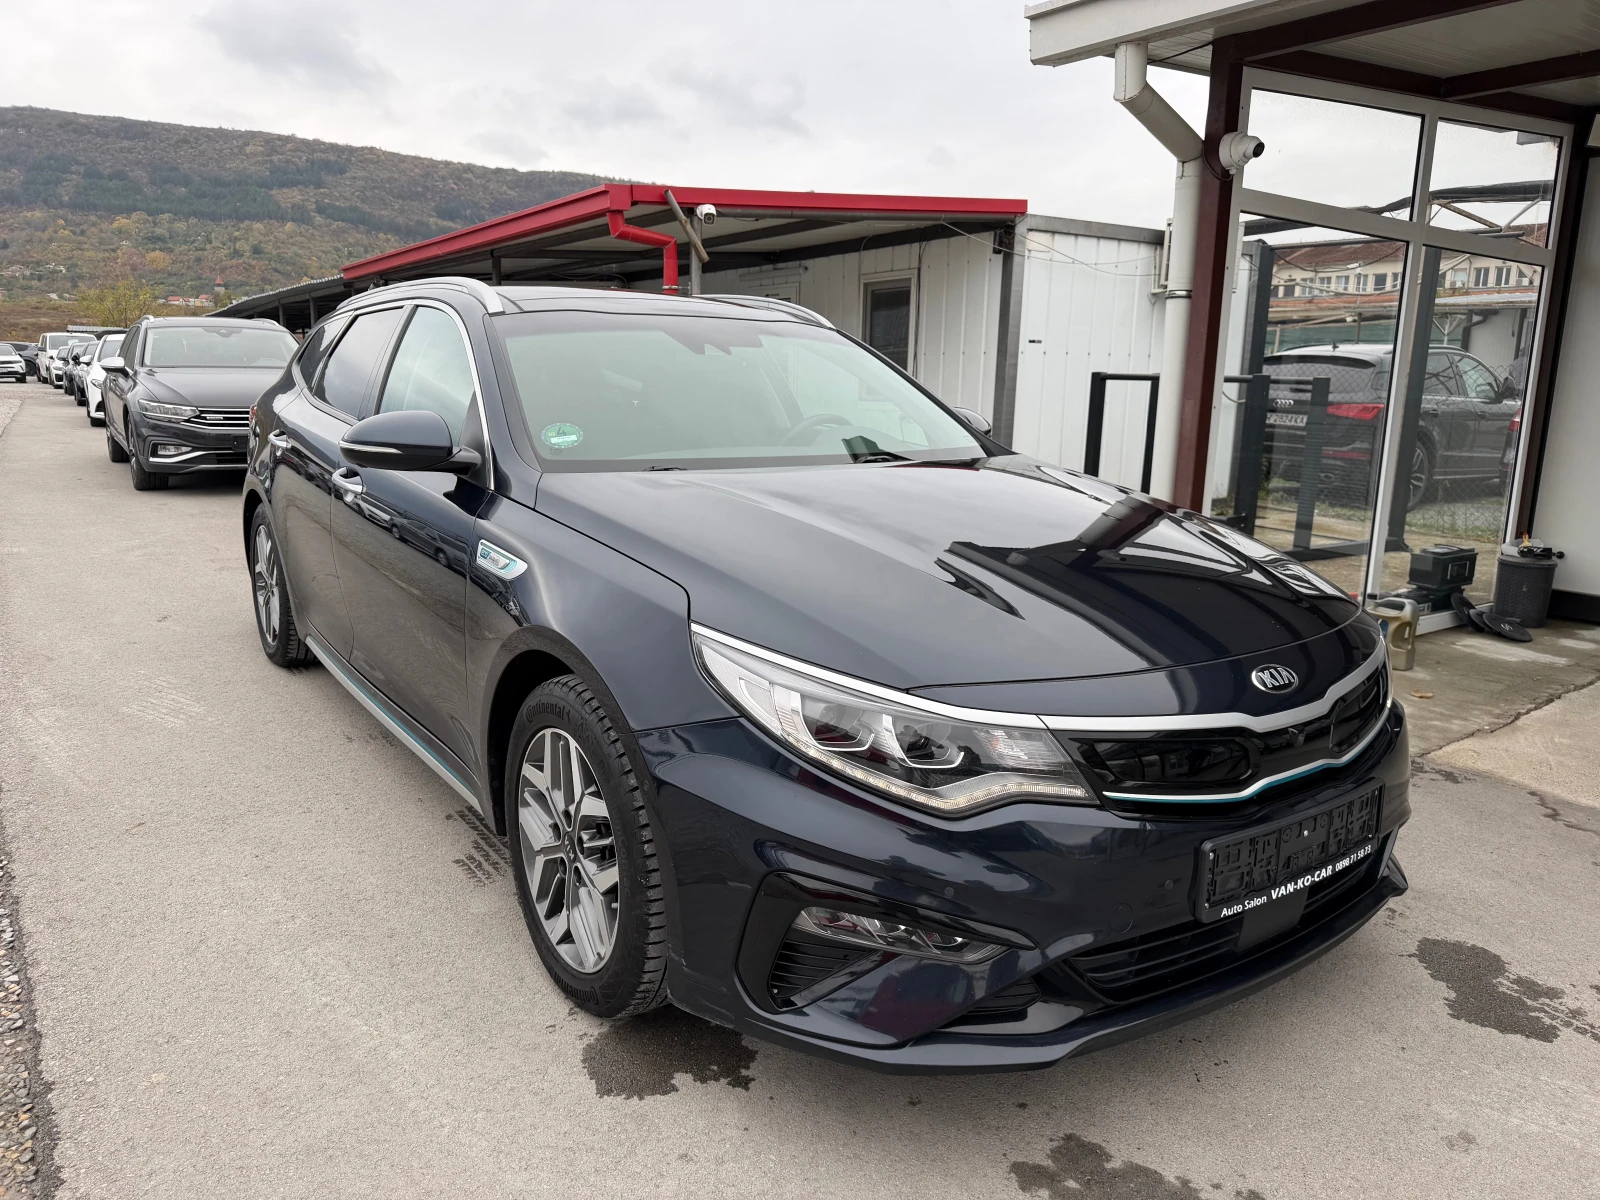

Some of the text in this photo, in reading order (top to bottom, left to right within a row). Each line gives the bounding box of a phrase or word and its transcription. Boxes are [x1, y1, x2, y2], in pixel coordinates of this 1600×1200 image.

[1257, 667, 1295, 688] KIA
[526, 699, 566, 723] Continental
[1220, 844, 1372, 918] Auto Salon VAN-KO-CAR 0898 71 58 73
[554, 971, 599, 1006] Continental
